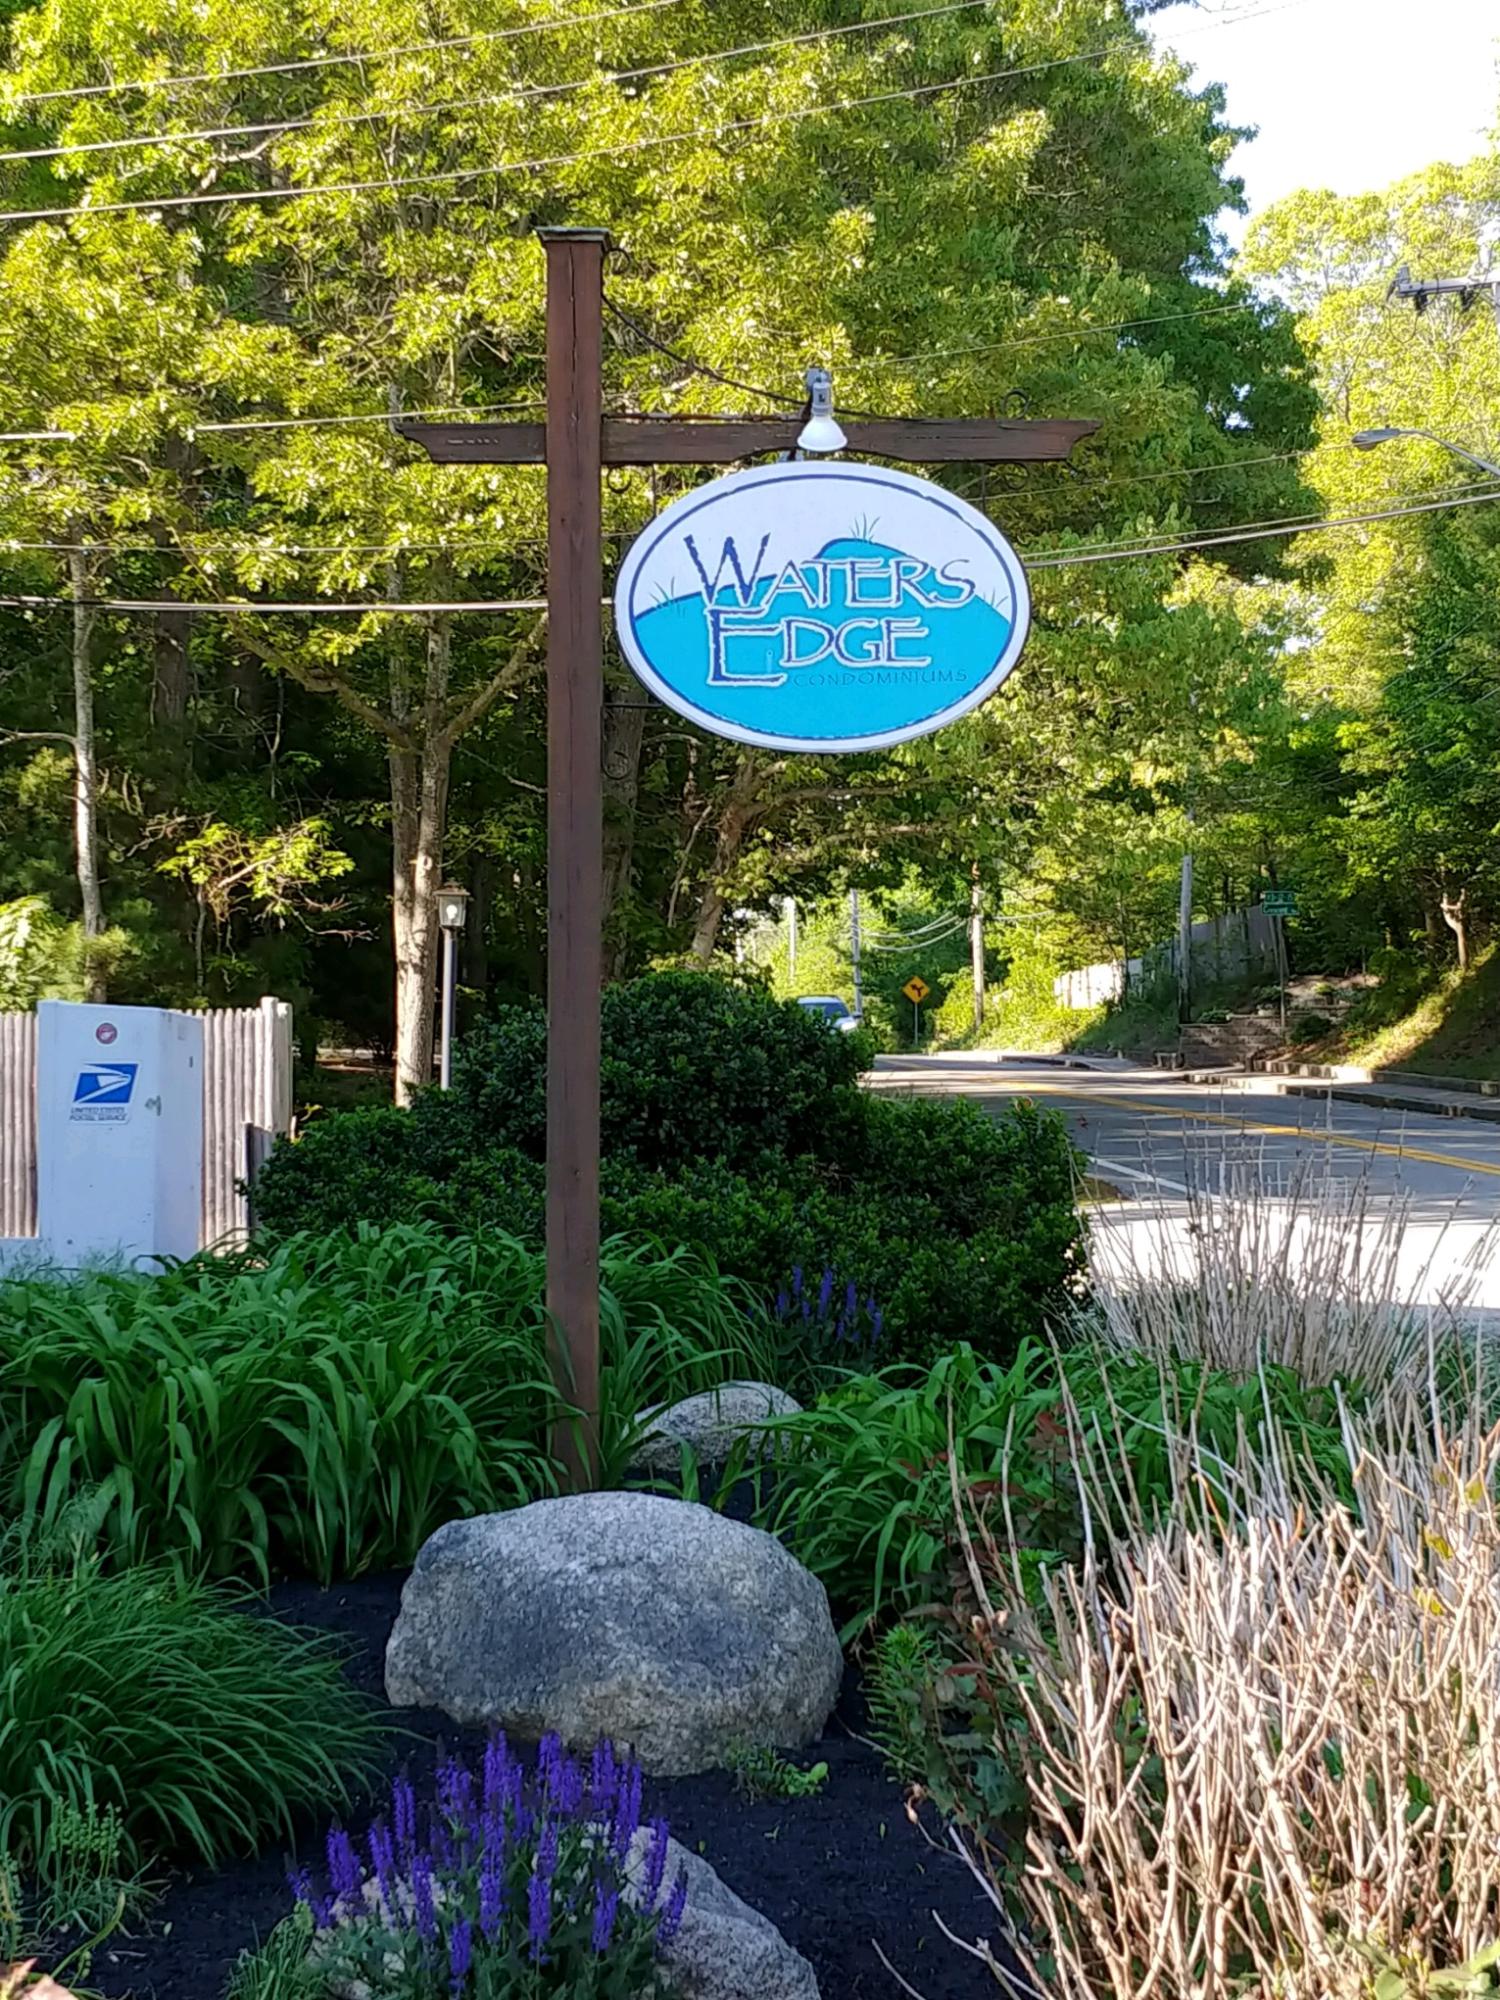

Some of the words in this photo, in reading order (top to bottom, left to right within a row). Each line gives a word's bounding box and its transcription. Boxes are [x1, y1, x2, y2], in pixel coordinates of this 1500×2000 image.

[683, 532, 976, 608] WATERS
[705, 607, 932, 688] EDGE
[793, 669, 968, 687] CONDOMINIUMS
